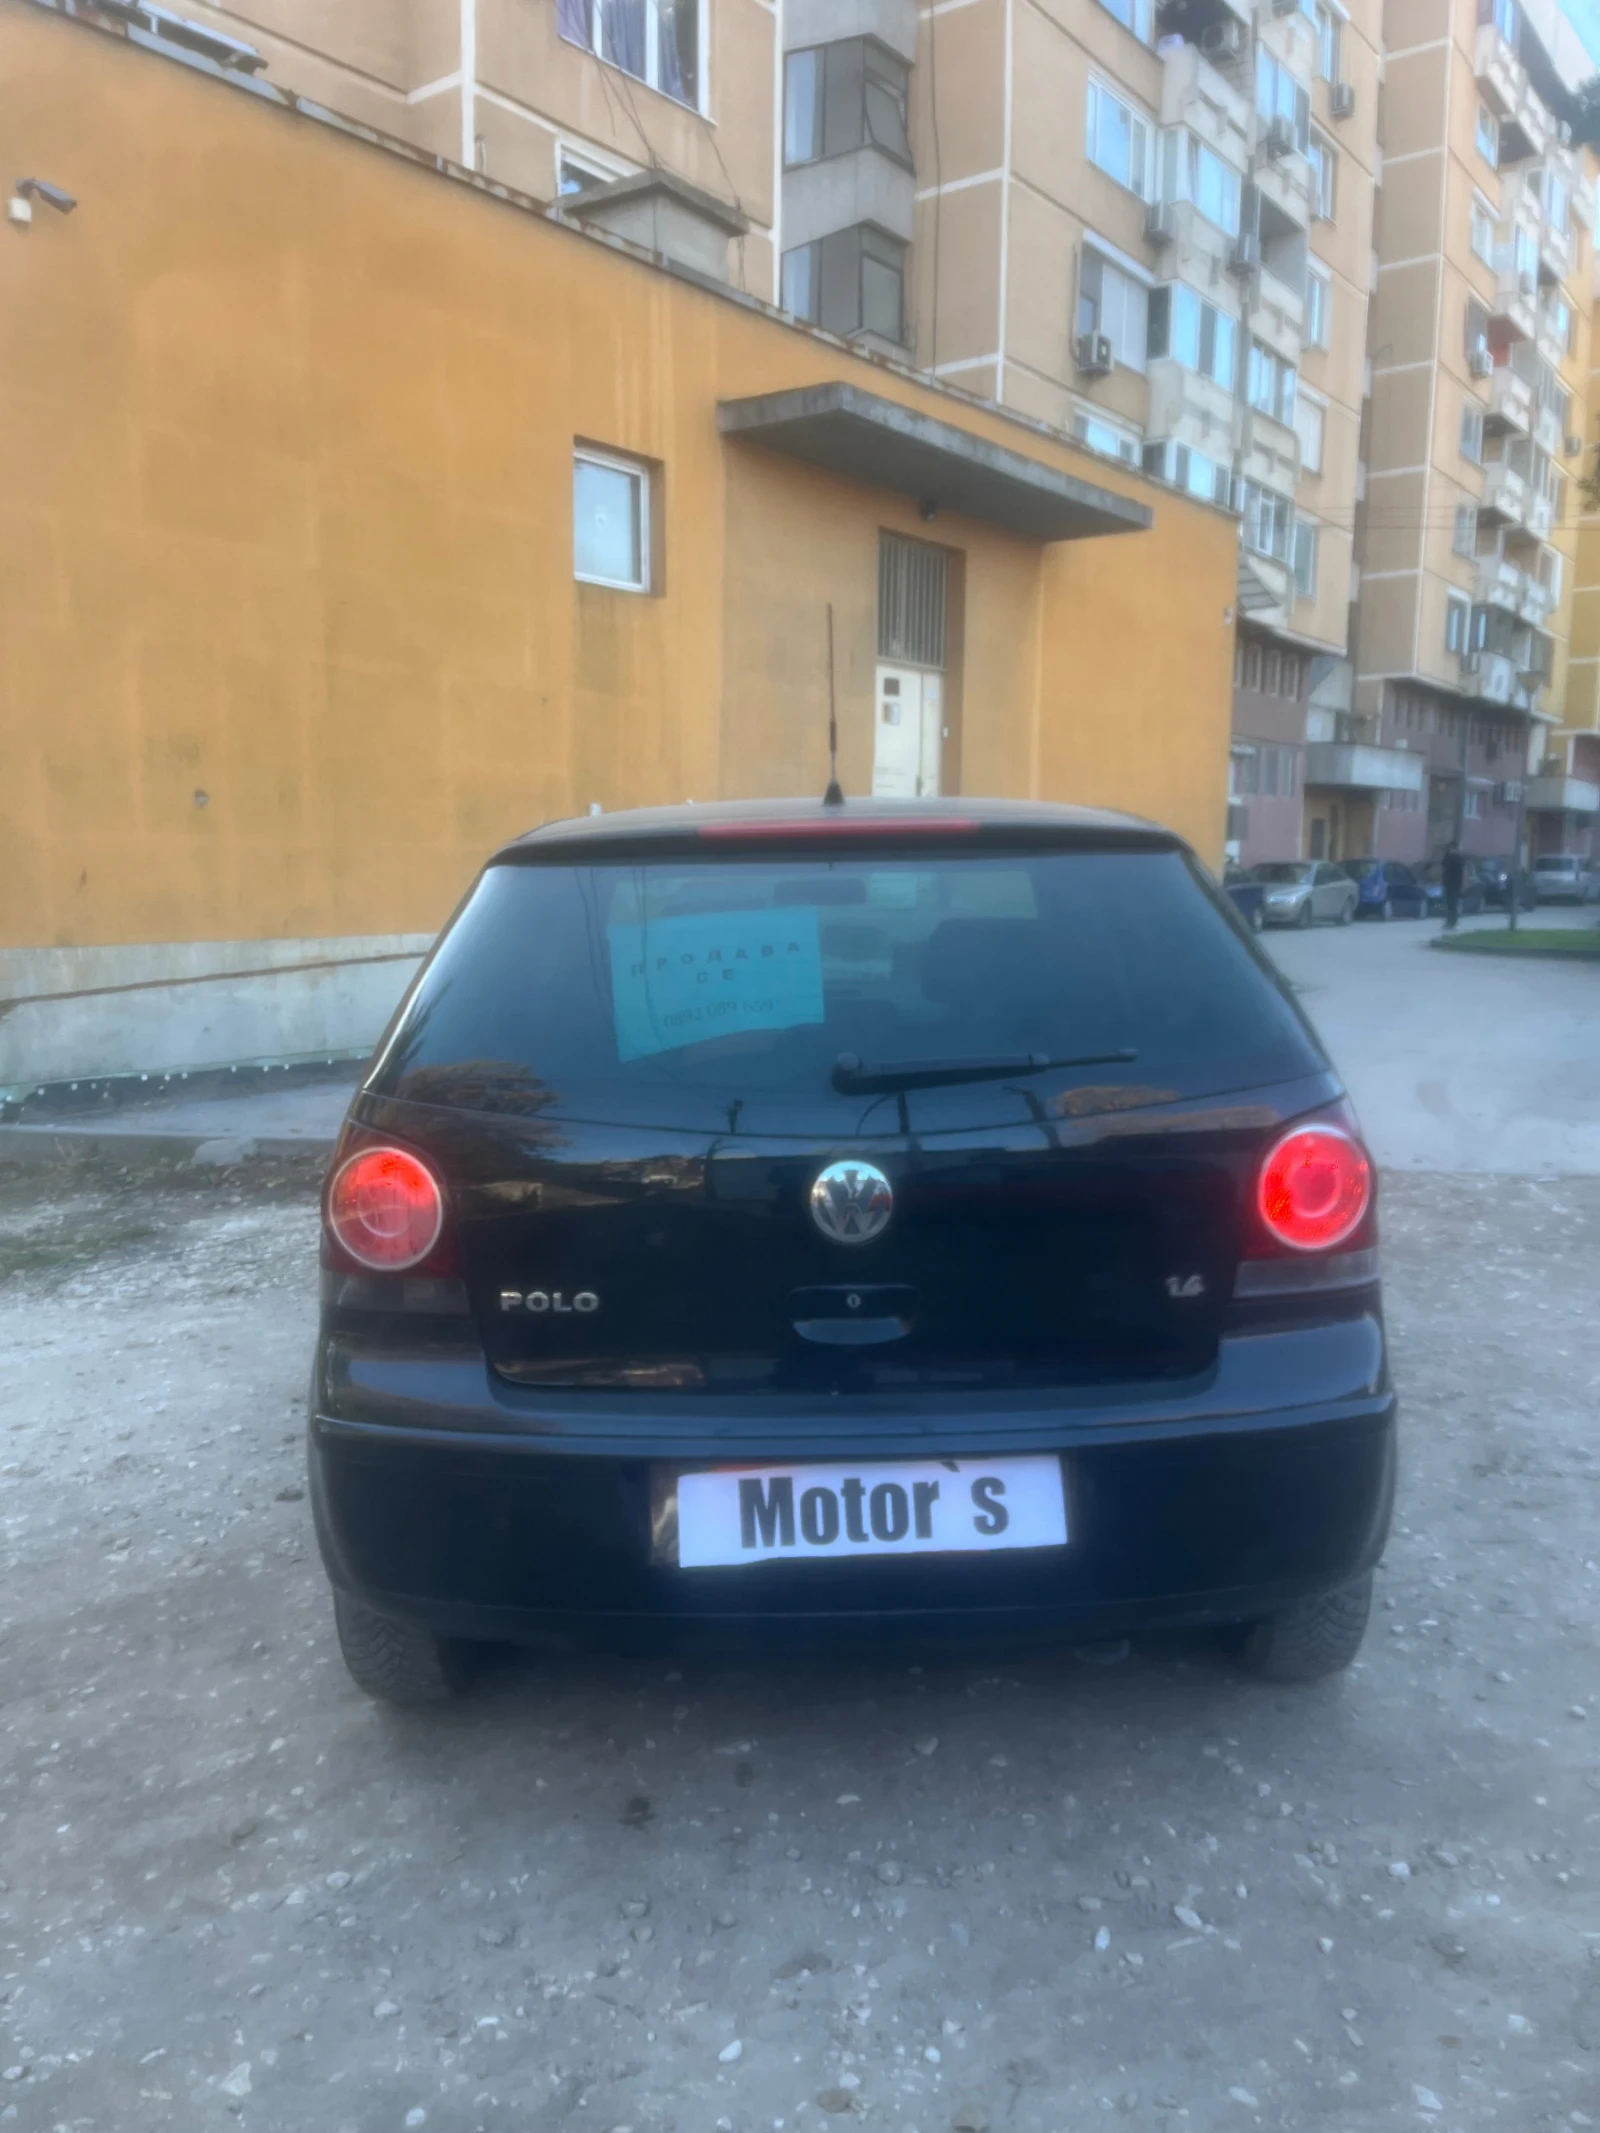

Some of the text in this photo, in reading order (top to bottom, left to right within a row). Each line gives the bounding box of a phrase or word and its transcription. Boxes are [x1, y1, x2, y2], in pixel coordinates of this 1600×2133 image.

[631, 941, 800, 977] ПРОДАВА
[696, 967, 735, 984] СЕ
[500, 1291, 599, 1312] POLO
